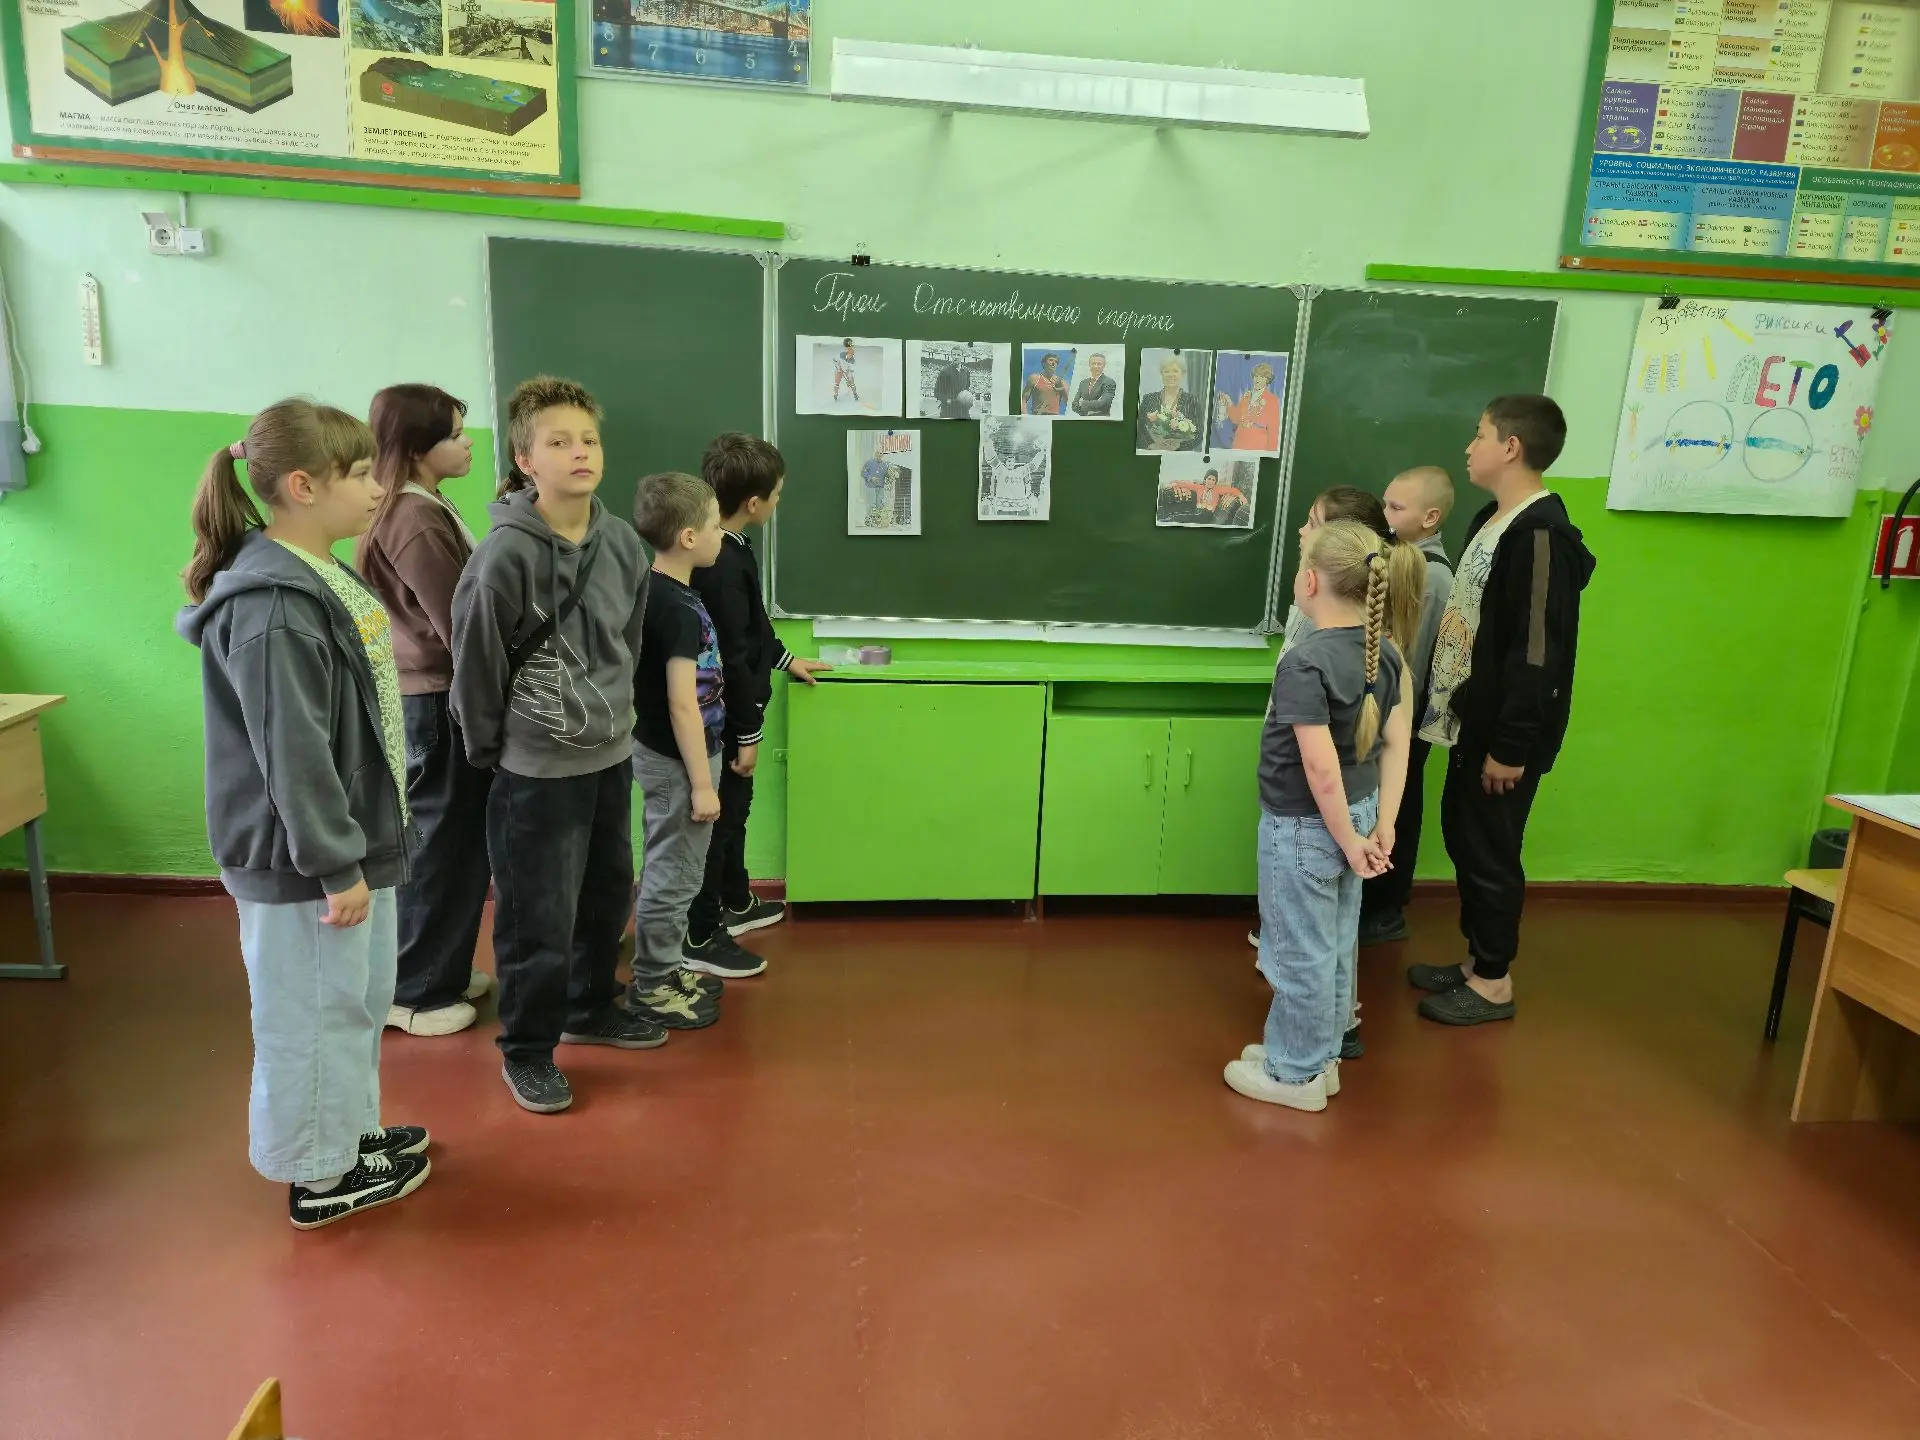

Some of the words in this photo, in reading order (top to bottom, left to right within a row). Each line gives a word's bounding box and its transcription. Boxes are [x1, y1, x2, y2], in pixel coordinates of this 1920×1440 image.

[603, 25, 615, 42] 8
[648, 43, 660, 61] 7
[695, 48, 706, 65] 6
[788, 41, 799, 58] 4
[744, 53, 756, 70] 5
[59, 111, 91, 121] МАГМА
[363, 126, 428, 139] ЗЕМЛЕТРЯСЕНИЕ
[1599, 159, 1633, 168] УРОВЕНЬ
[1759, 168, 1796, 179] РАЗВИТИЯ
[812, 272, 888, 321] Герои
[912, 282, 1081, 325] Отечественного
[1097, 306, 1175, 340] спорта
[1726, 352, 1840, 411] ЛЕТО
